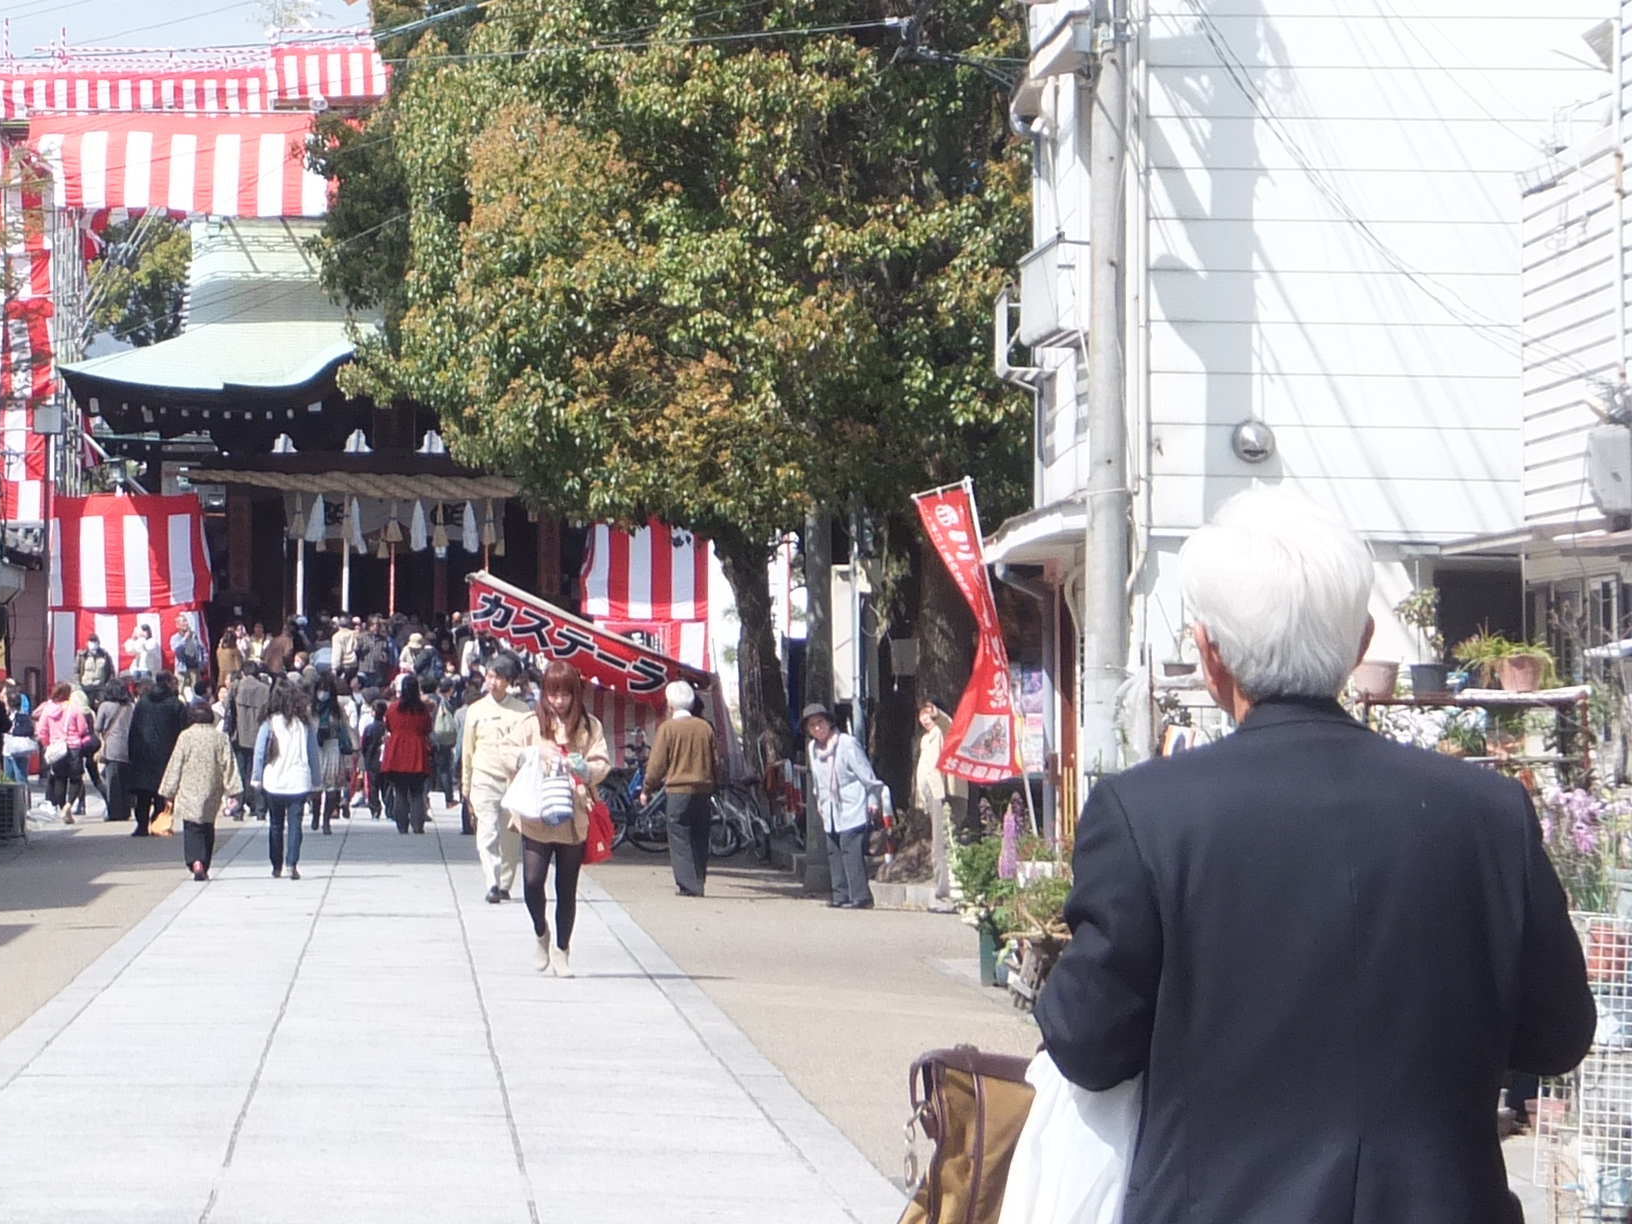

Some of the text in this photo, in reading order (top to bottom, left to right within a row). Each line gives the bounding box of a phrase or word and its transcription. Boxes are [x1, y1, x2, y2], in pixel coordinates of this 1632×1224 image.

[471, 591, 668, 693] カステーラ
